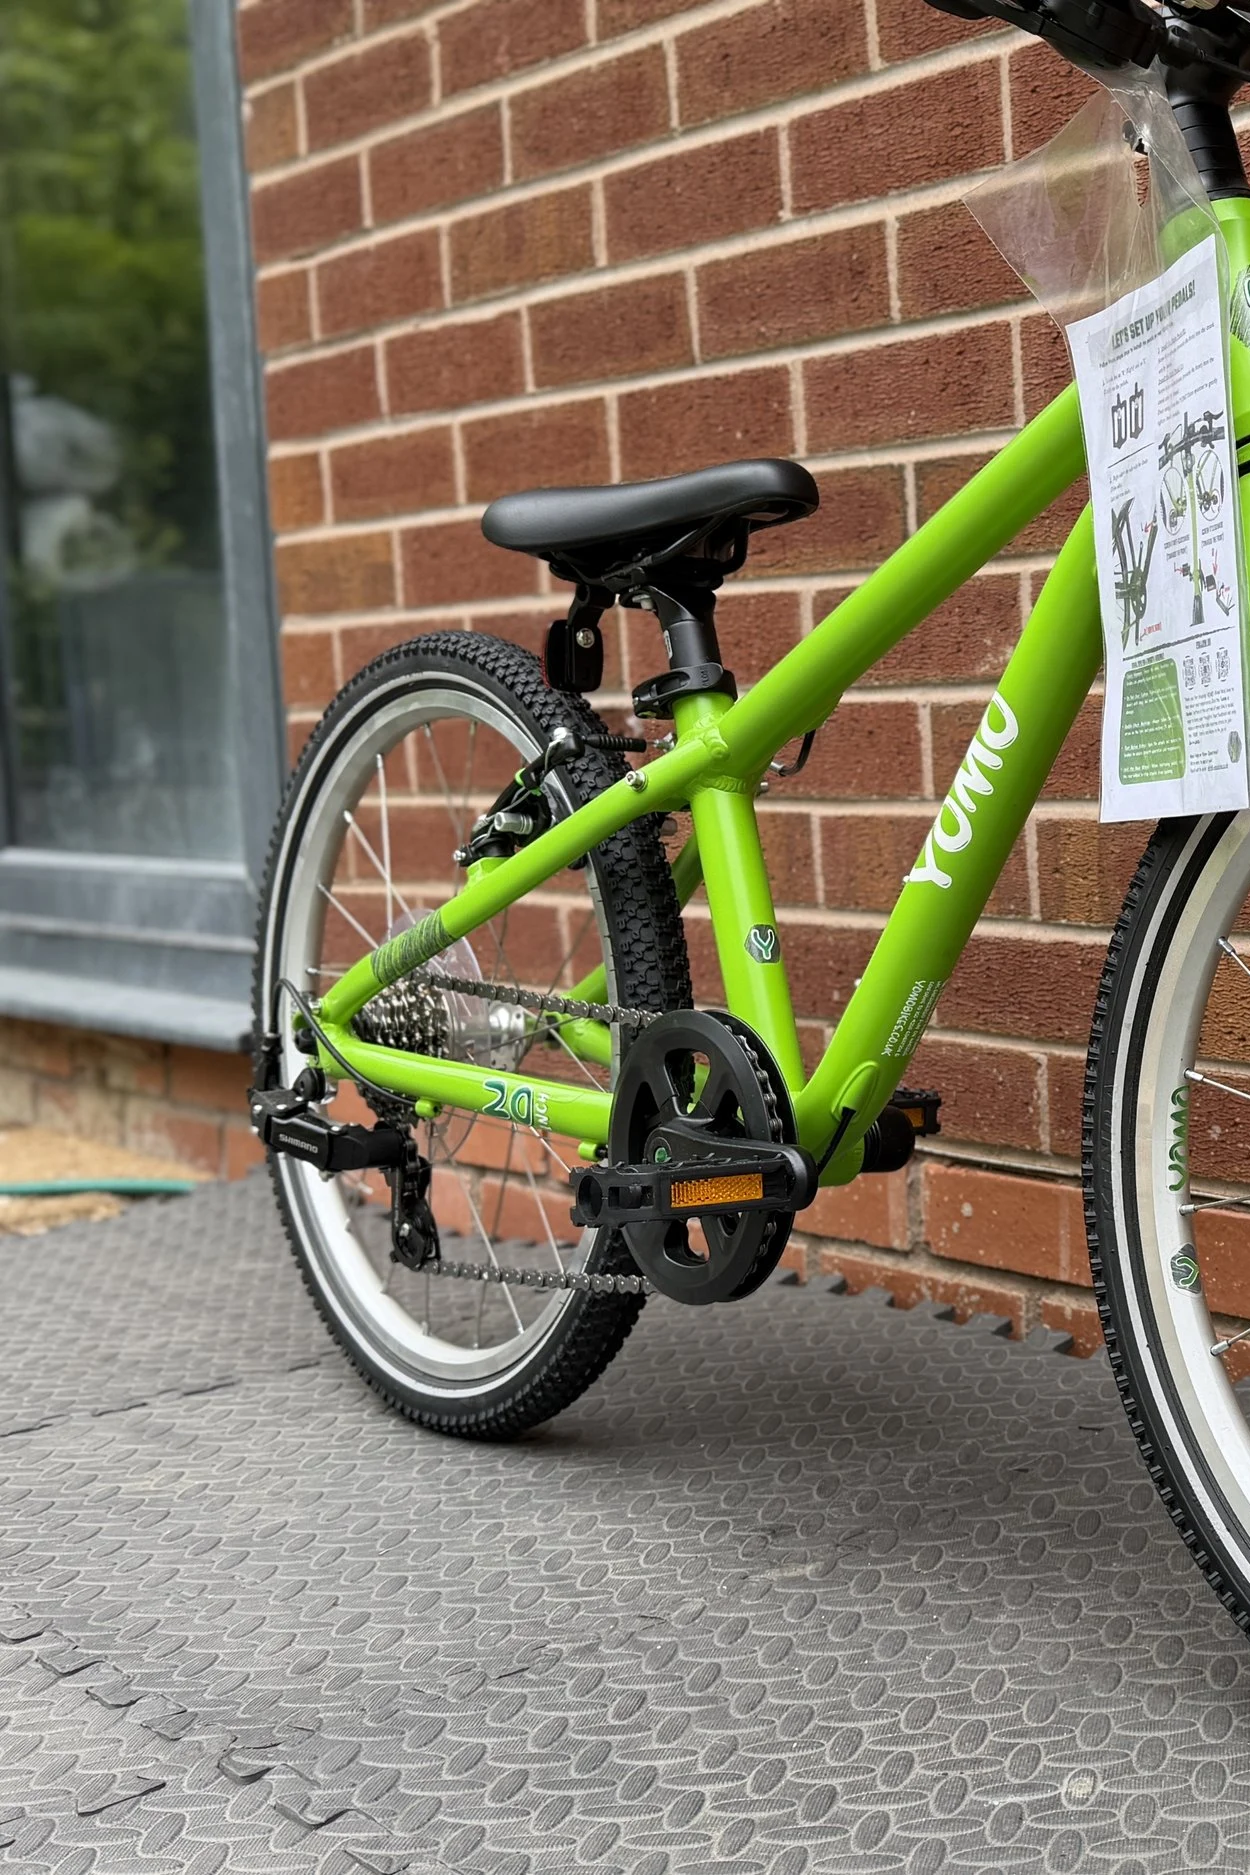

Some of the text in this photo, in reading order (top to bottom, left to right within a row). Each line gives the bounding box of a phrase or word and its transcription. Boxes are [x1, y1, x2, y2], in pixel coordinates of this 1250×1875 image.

[1111, 326, 1130, 350] LET'S
[1129, 318, 1145, 340] SET
[1145, 311, 1155, 332] UP
[1171, 279, 1196, 313] PEDALS!
[903, 690, 1020, 889] YOMO
[750, 928, 776, 960] Y
[881, 979, 927, 1057] YOMOBIKES.CO.UK
[482, 1077, 553, 1132] 20 INCH
[278, 1132, 319, 1155] SHIMANO
